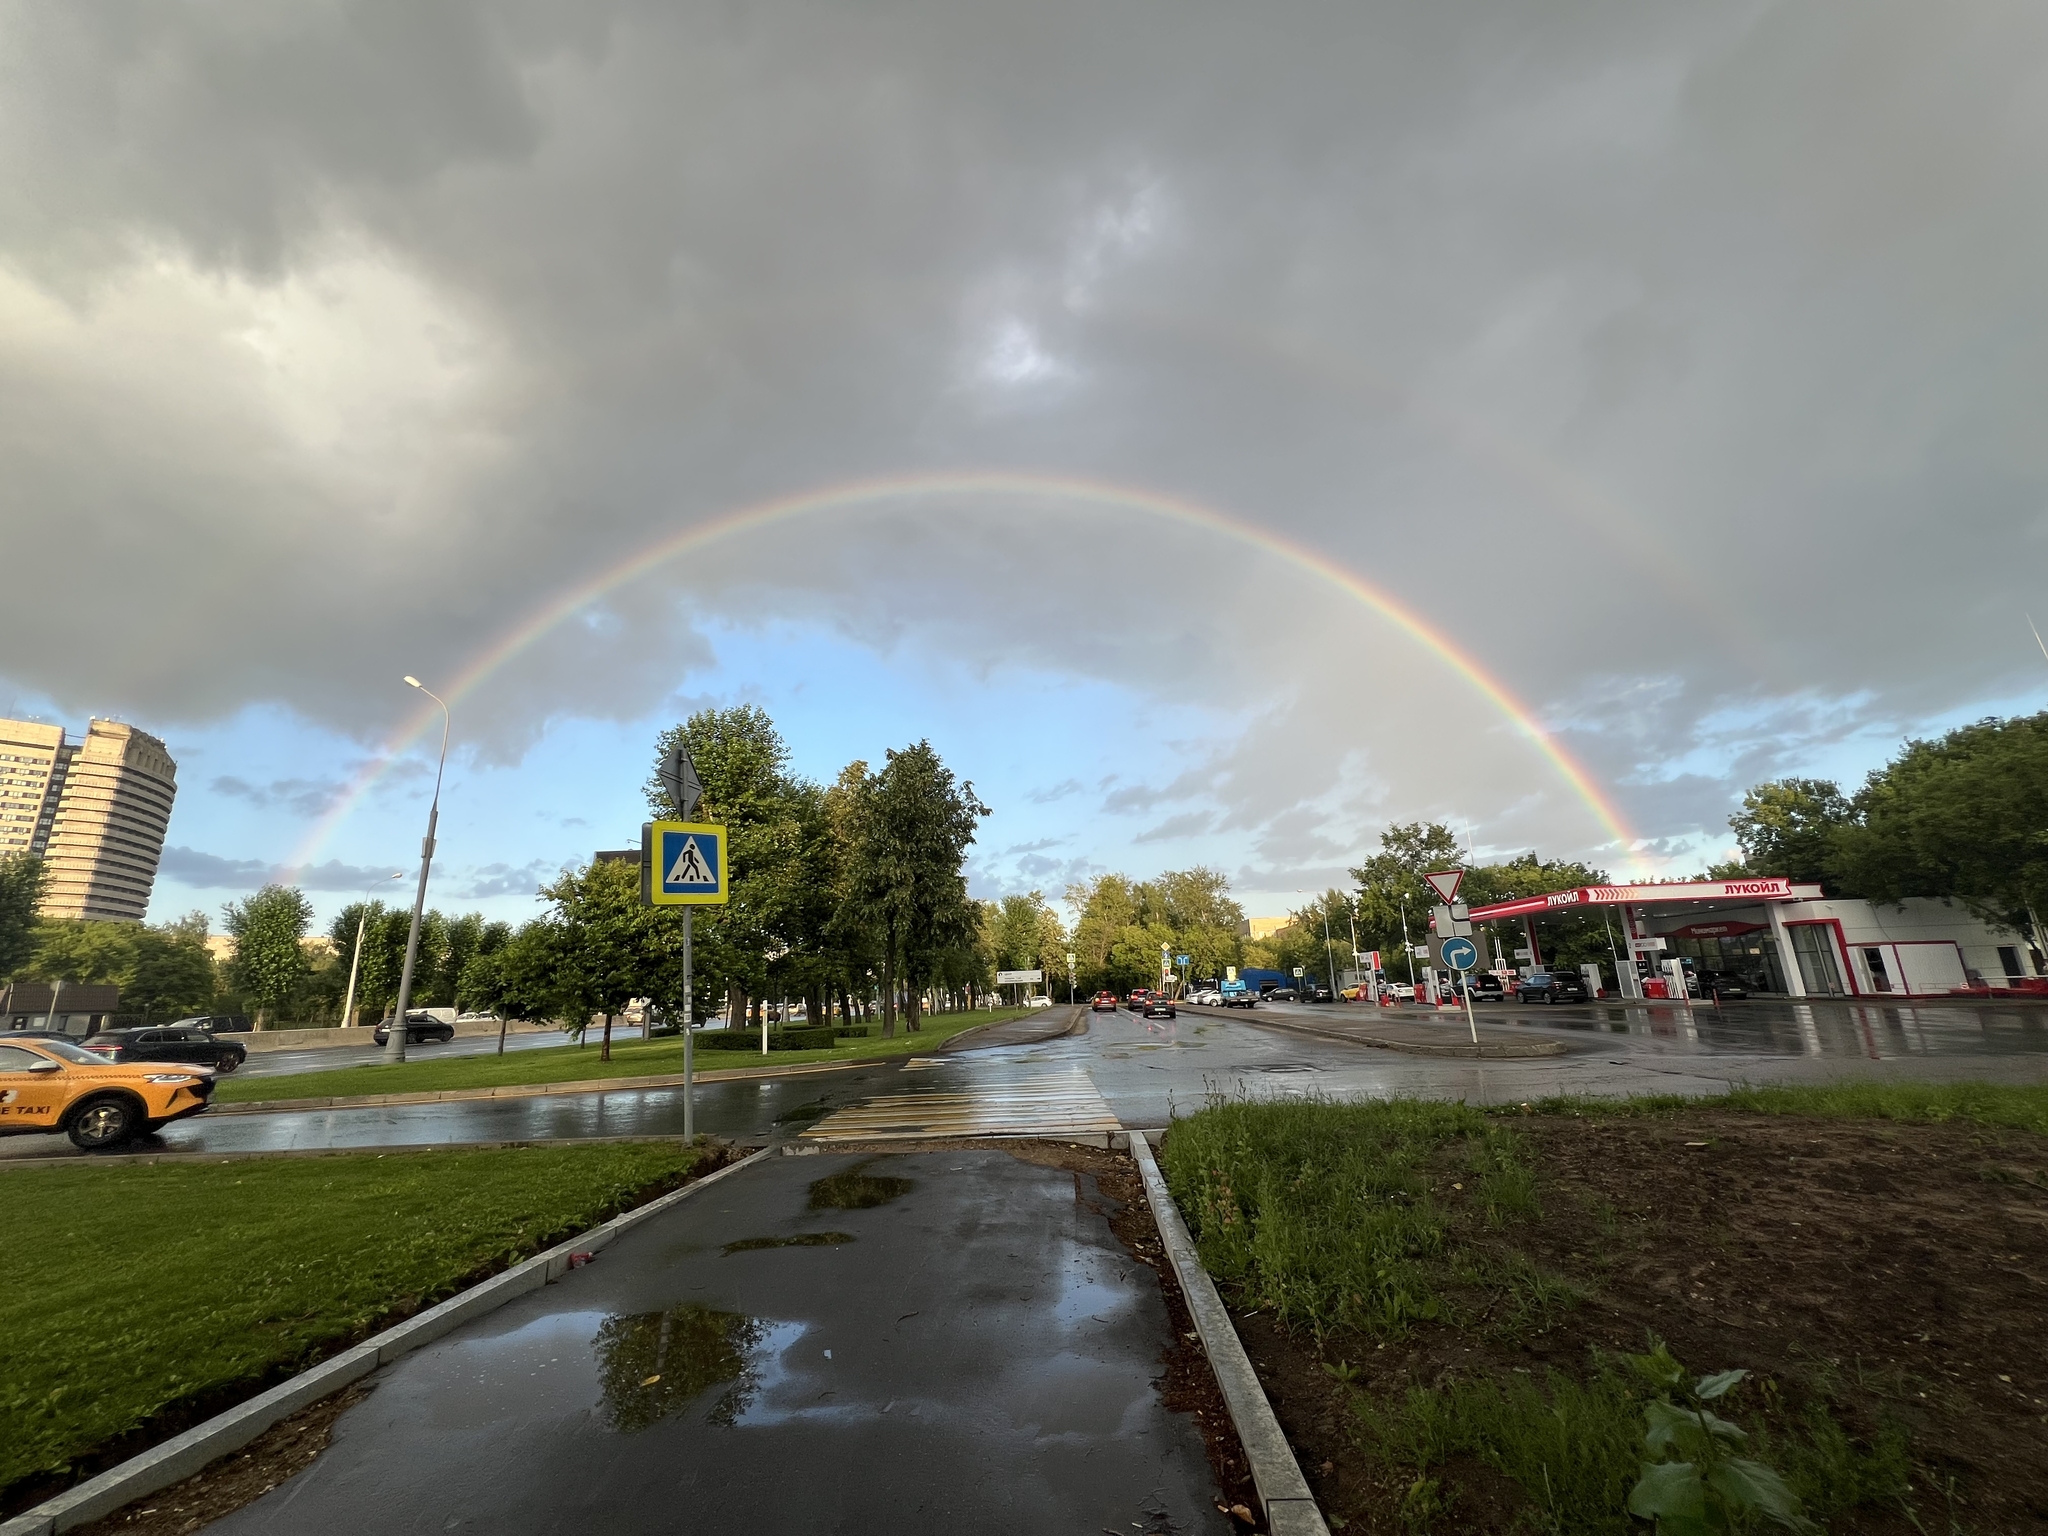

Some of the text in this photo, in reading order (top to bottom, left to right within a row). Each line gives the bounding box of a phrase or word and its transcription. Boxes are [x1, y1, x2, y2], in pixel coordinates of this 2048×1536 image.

[1724, 881, 1780, 894] ЛУКОЙЛ
[1547, 890, 1579, 906] ЛУКОЙЛ
[16, 1105, 51, 1115] TAXI
